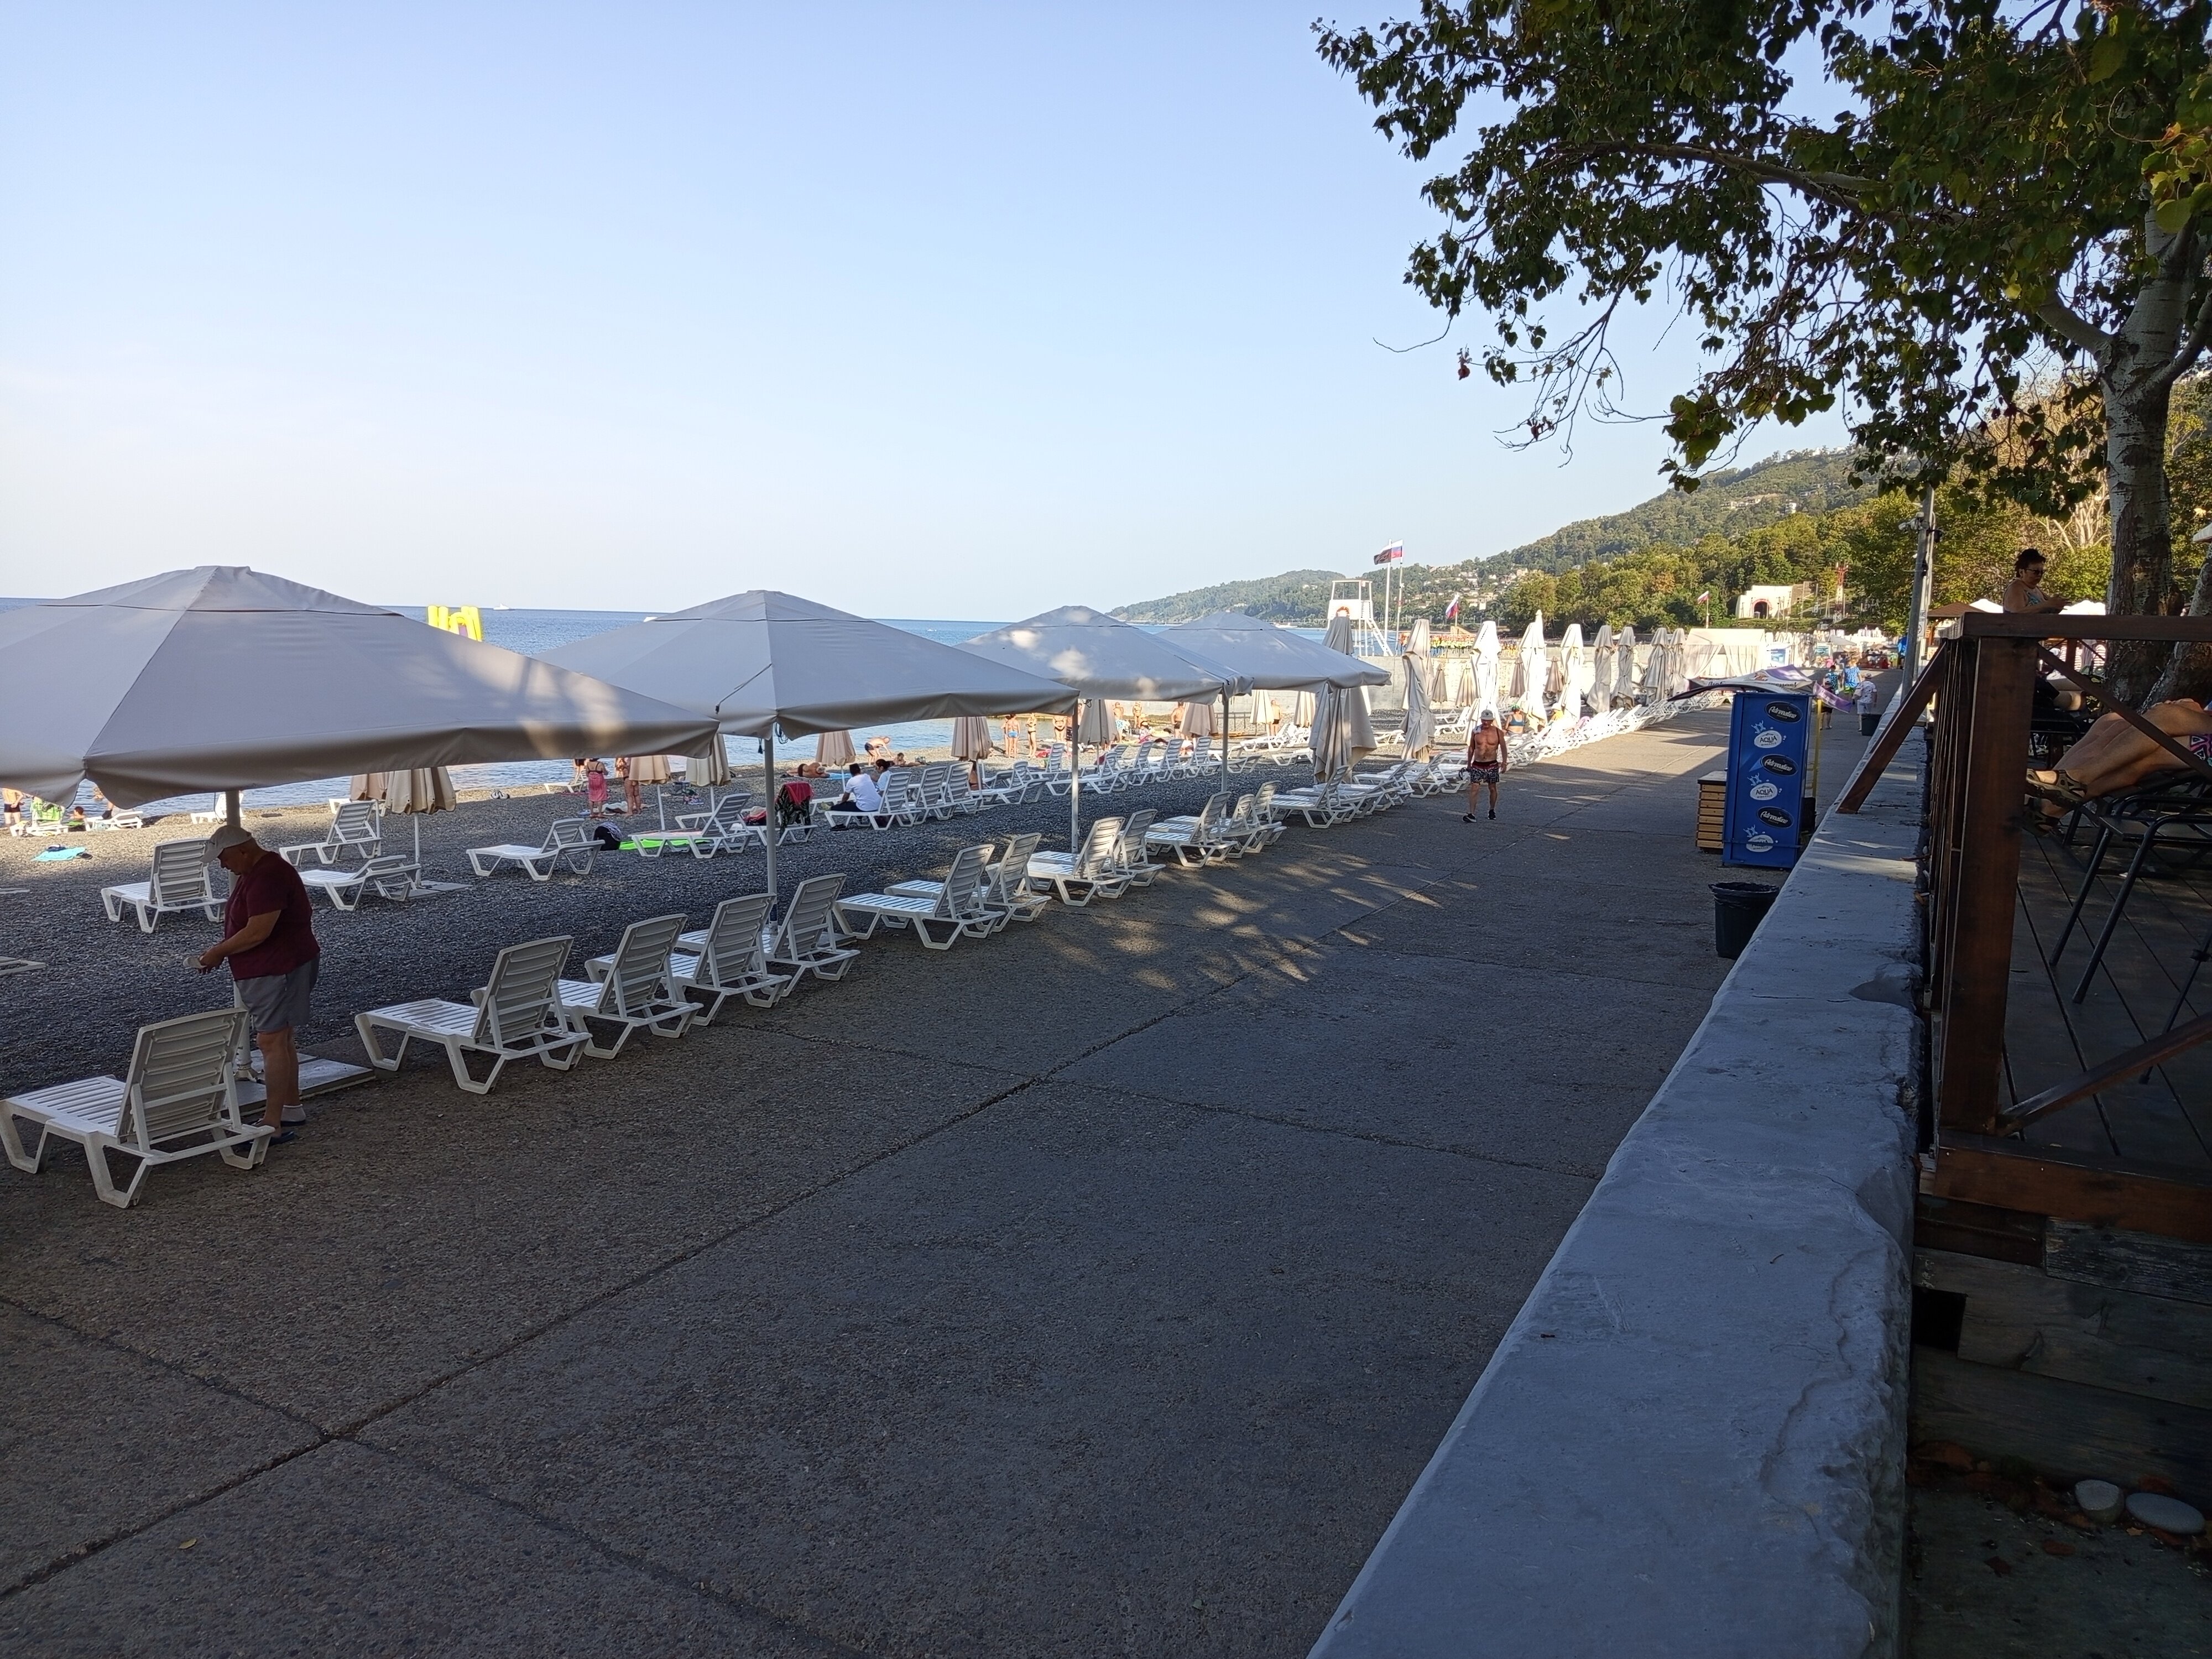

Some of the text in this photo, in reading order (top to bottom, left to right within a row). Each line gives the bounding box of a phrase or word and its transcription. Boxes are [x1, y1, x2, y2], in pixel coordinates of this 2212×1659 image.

[1768, 706, 1797, 718] Adrenaline
[1764, 759, 1793, 771] Adrenaline
[1760, 811, 1788, 824] Adrenaline
